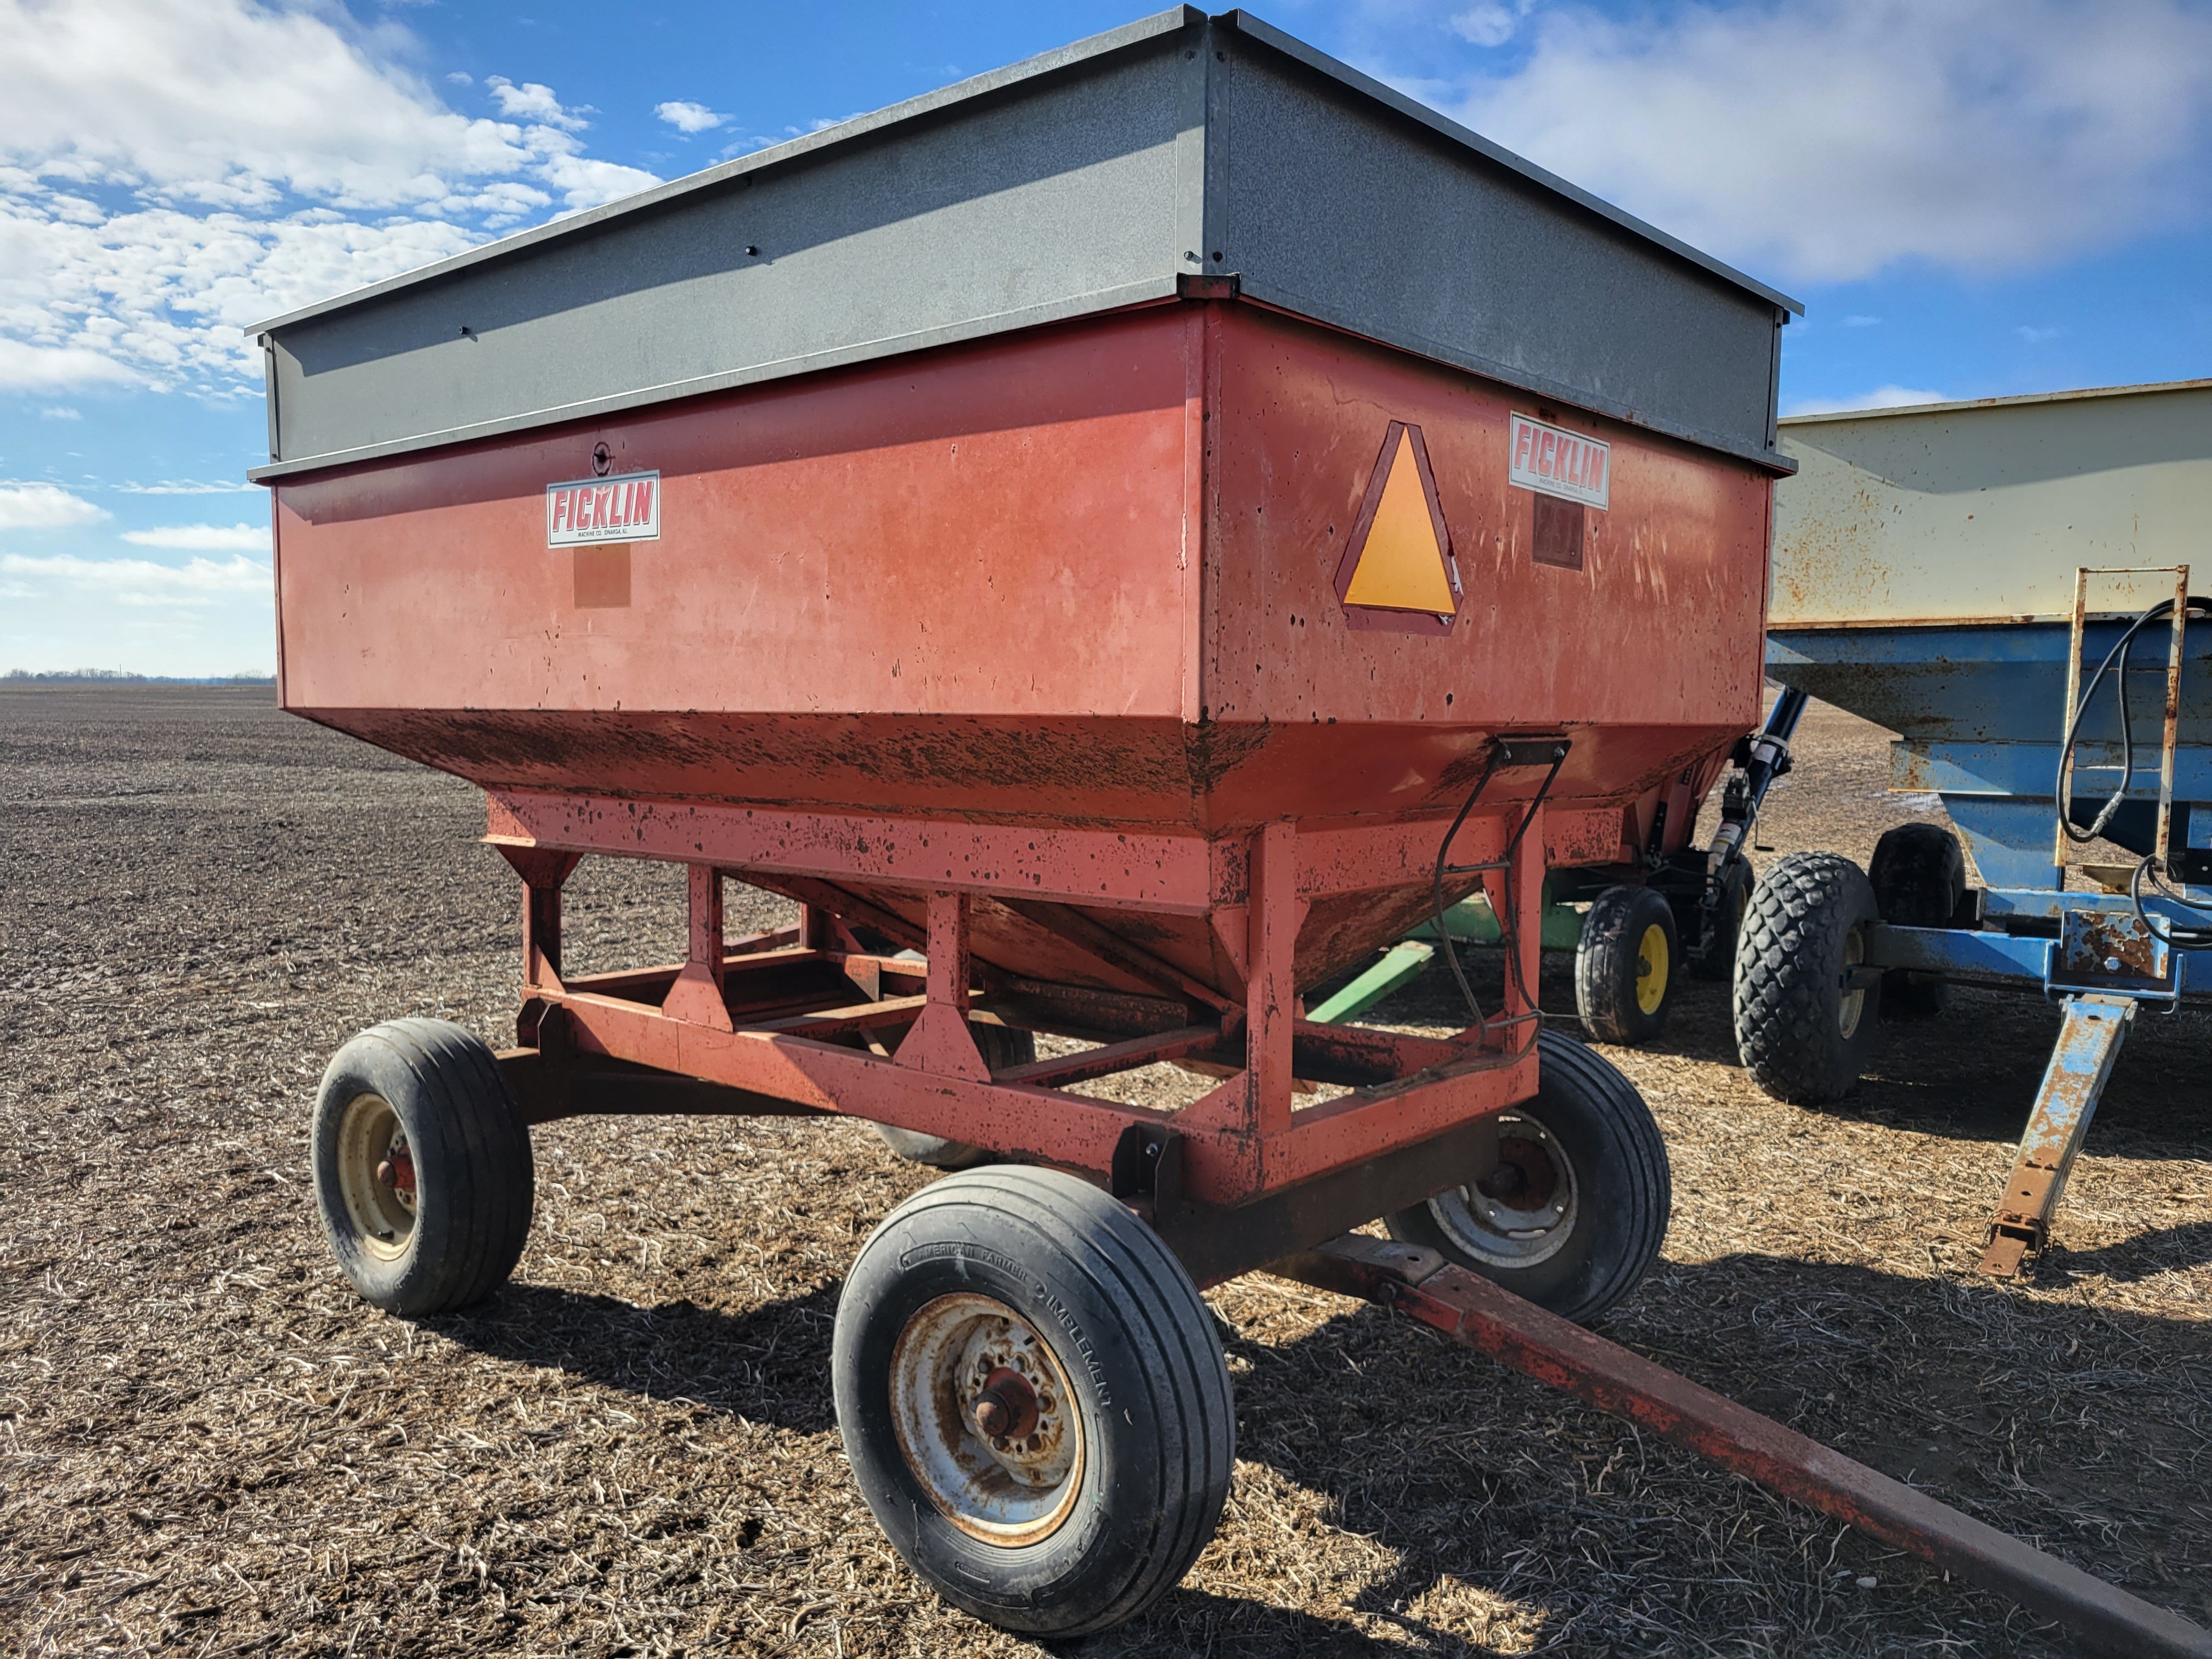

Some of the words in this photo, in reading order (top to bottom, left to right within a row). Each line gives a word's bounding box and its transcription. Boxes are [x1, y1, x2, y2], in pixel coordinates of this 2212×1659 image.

[1514, 423, 1606, 492] FICKLIN
[552, 481, 654, 533] FICKLIN
[919, 1243, 975, 1260] AMERICAN
[981, 1250, 1028, 1282] FARMER
[1046, 1294, 1111, 1407] IMPLEMENT
